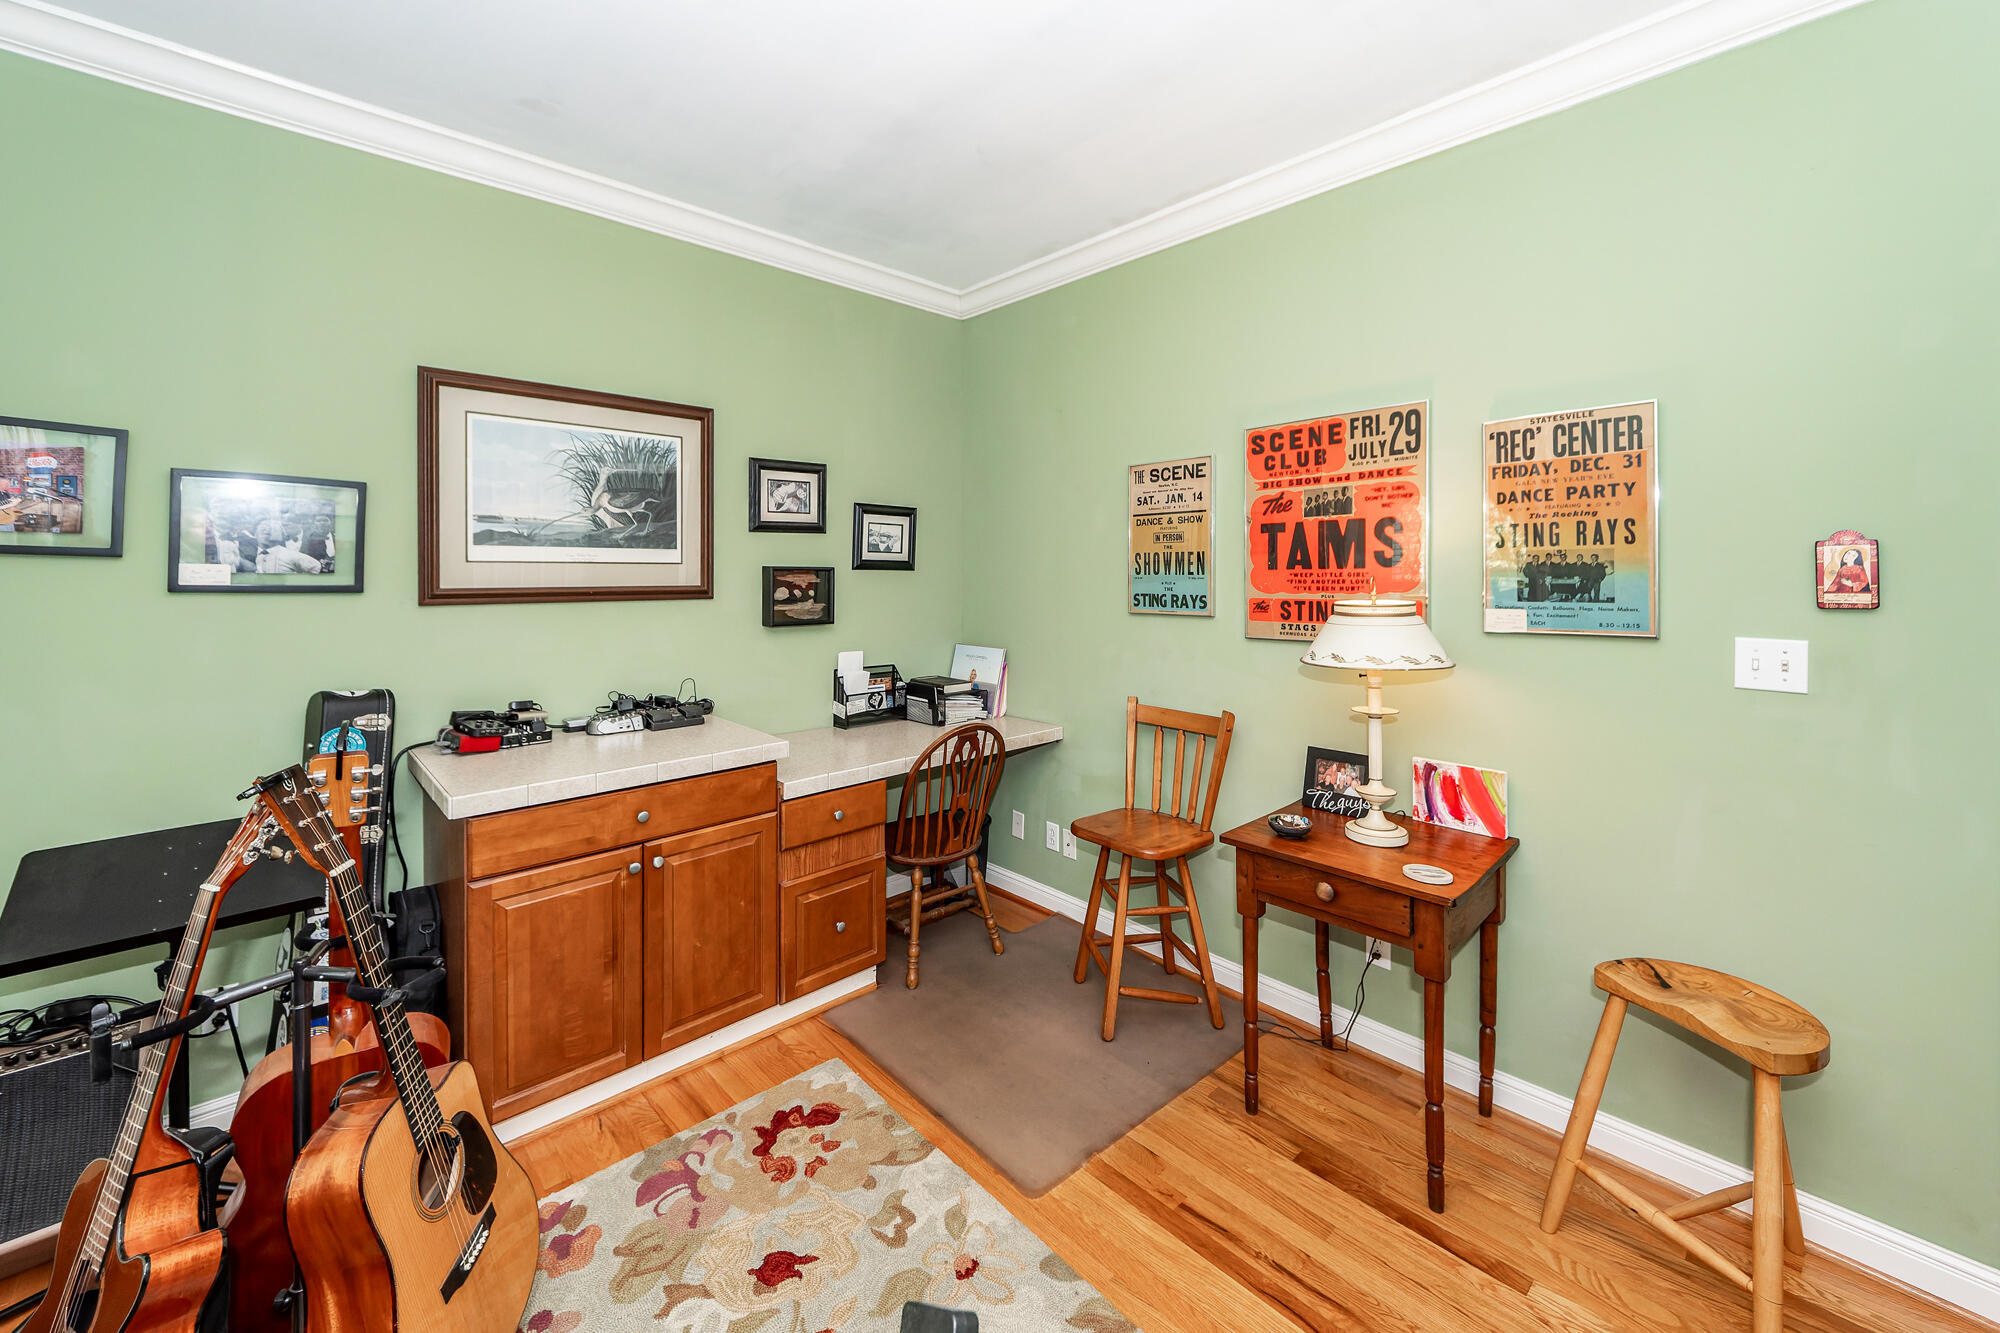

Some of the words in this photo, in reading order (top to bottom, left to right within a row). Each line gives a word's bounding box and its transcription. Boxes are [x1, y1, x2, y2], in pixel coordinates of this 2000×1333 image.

[1350, 413, 1386, 440] FRI.
[1530, 410, 1594, 425] STATESVILLE
[1251, 422, 1343, 455] SCENE
[1388, 408, 1421, 456] 29
[1552, 414, 1643, 458] CENTER
[1264, 448, 1327, 471] CLUB
[1348, 439, 1387, 461] JULY
[1134, 470, 1145, 485] THE
[1149, 462, 1206, 482] SCENE
[1492, 461, 1559, 480] FRIDAY,
[1570, 457, 1610, 473] DEC.
[1623, 453, 1642, 469] 31
[1263, 481, 1282, 489] BIG
[1288, 476, 1321, 487] SHOW
[1328, 473, 1350, 482] and
[1358, 468, 1402, 479] DANCE
[1165, 492, 1187, 504] JAN.
[1193, 491, 1203, 502] 14
[1263, 492, 1293, 516] The
[1496, 488, 1554, 505] DANCE
[1566, 481, 1636, 500] PARTY
[1544, 502, 1582, 510] FEATURING
[1552, 510, 1599, 518] Rocking
[1136, 517, 1164, 527] DANCE
[1167, 517, 1174, 525] &
[1177, 514, 1204, 525] SHOW
[1154, 534, 1161, 542] IN
[1162, 533, 1183, 542] PERSON
[1261, 517, 1404, 570] TAMS
[1495, 521, 1560, 549] STING
[1576, 518, 1636, 546] RAYS
[1134, 551, 1205, 575] SHOWMEN
[1133, 593, 1168, 608] STING
[1170, 594, 1208, 610] RAYS
[1253, 600, 1270, 613] The
[1281, 624, 1316, 632] STAGS
